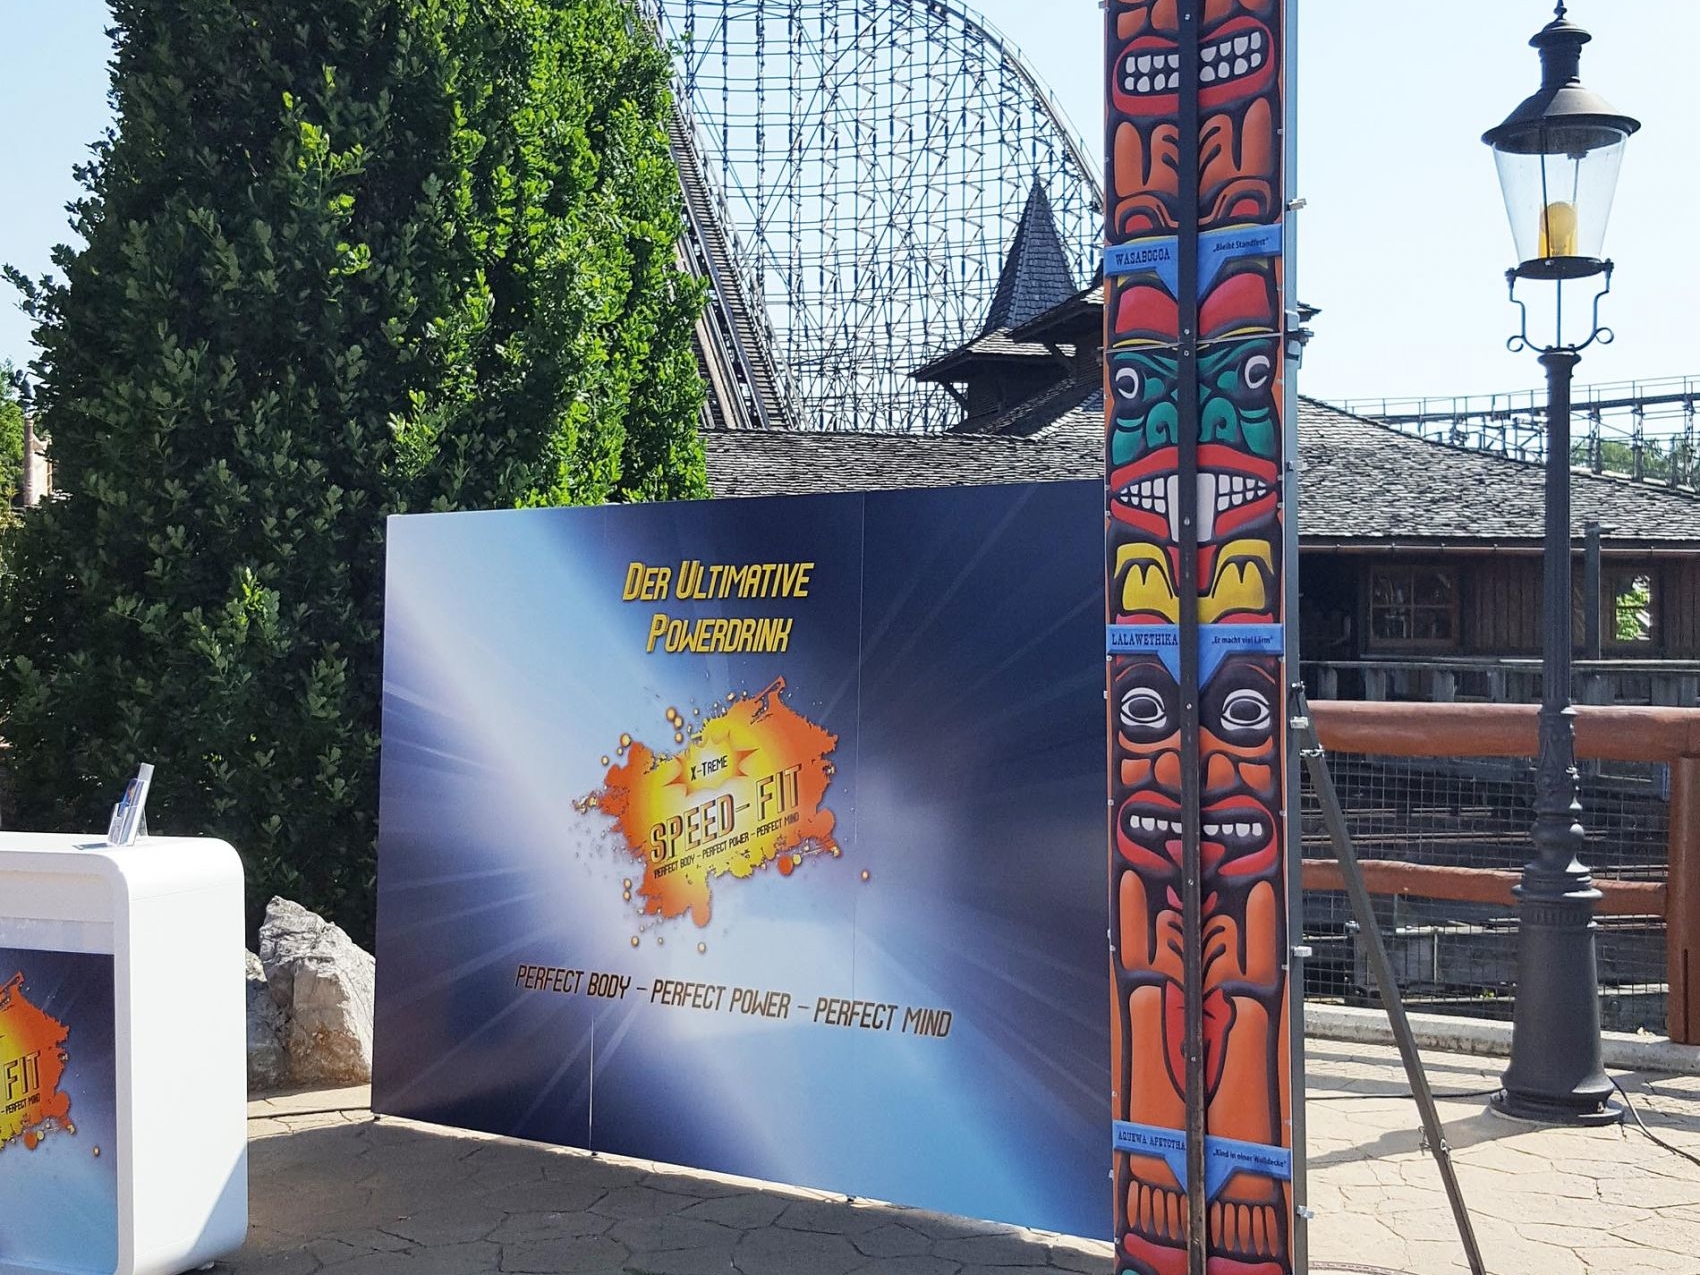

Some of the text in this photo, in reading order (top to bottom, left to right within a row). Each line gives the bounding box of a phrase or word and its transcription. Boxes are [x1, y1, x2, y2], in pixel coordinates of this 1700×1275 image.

[622, 560, 815, 601] DER ULTIMATIVE
[646, 613, 793, 653] POWERDRINK
[1111, 633, 1178, 646] LALAWETHIKA
[690, 755, 729, 782] X-TREME
[653, 858, 679, 879] PERFECT
[680, 853, 695, 868] BODY
[702, 840, 727, 860] PERFECT
[728, 832, 750, 847] POWER
[756, 820, 783, 838] PERFECT
[784, 812, 800, 827] MIND
[515, 964, 584, 994] PERFECT
[586, 972, 632, 1000] BODY
[650, 979, 726, 1011] PERFECT
[728, 987, 792, 1019] POWER
[813, 997, 899, 1031] PERFECT
[901, 1006, 953, 1038] MIND
[4, 1049, 41, 1101] FIT
[5, 1098, 27, 1115] PERFECT
